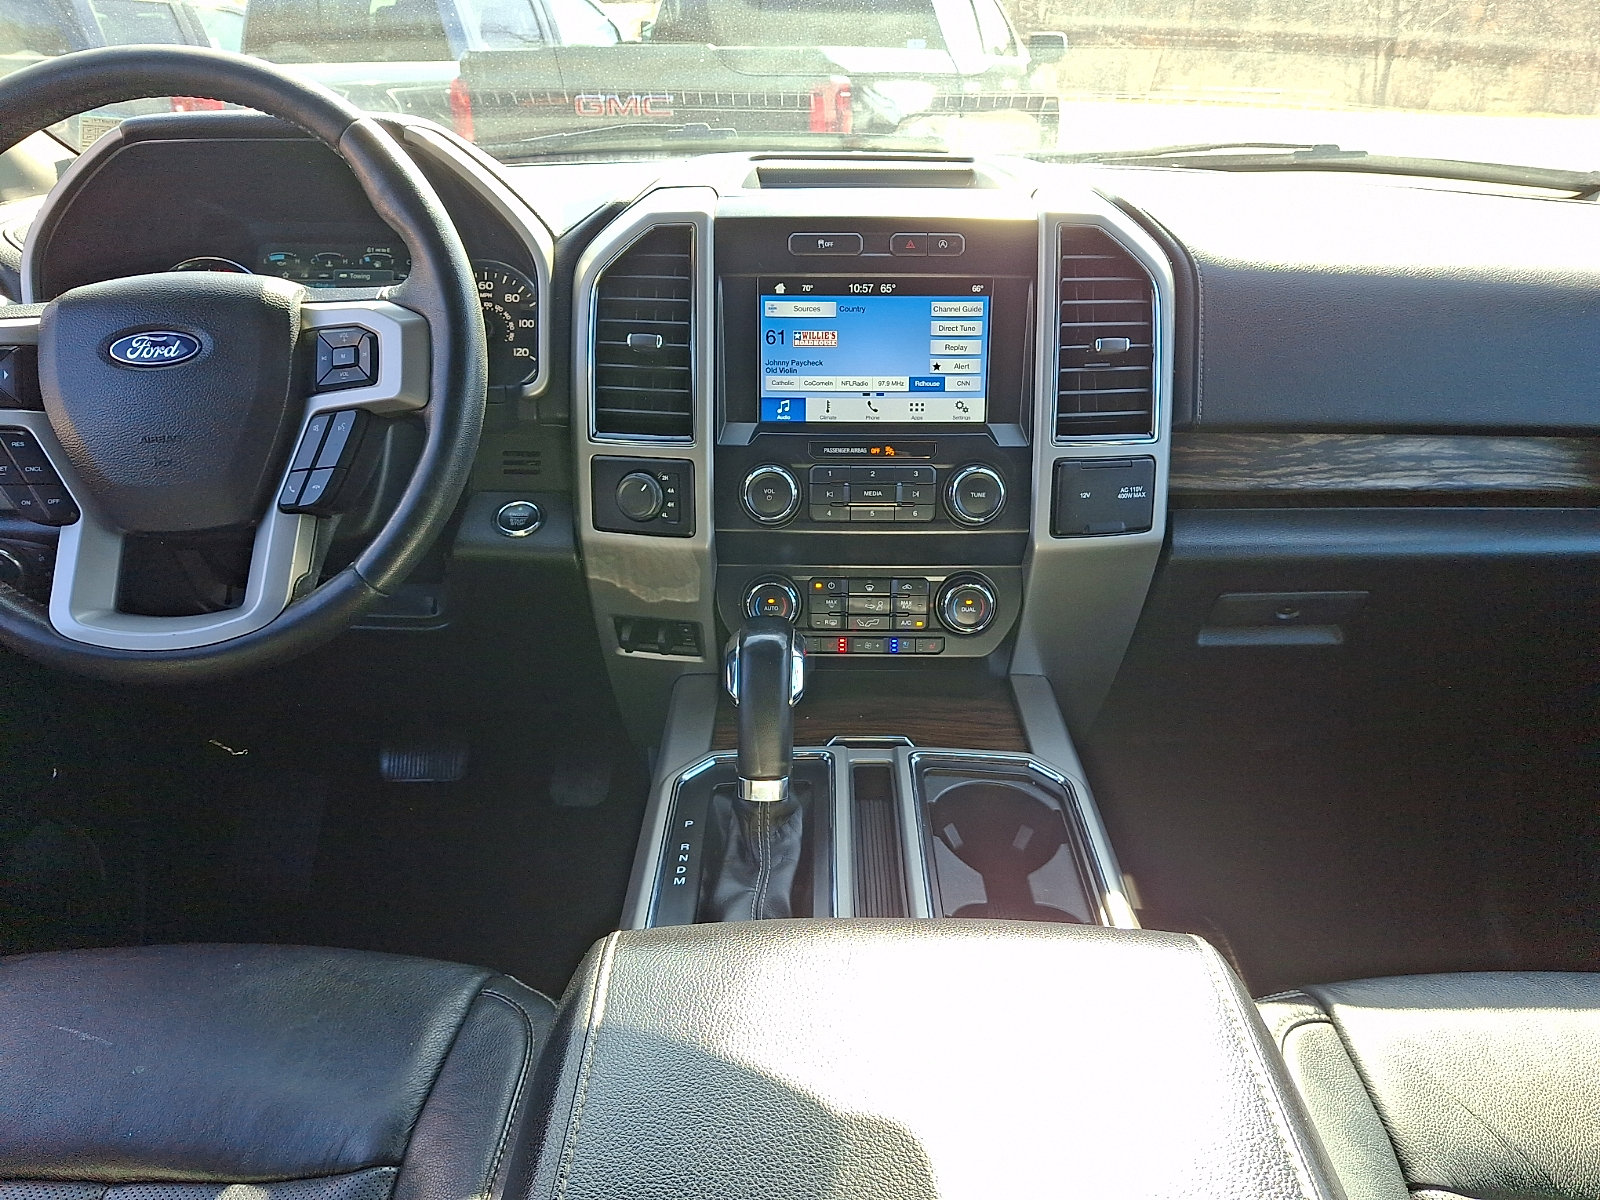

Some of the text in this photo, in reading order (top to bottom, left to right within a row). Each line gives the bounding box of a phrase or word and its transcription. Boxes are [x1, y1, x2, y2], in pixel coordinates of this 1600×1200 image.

[574, 94, 674, 117] GMC
[824, 240, 834, 248] OFF
[478, 281, 494, 290] 60
[848, 283, 874, 293] 10:57
[504, 293, 520, 303] 80
[839, 305, 866, 314] Country
[933, 305, 983, 313] Channel Guide
[518, 319, 535, 328] 100
[938, 324, 976, 332] Direct Tune
[765, 329, 785, 345] 61
[802, 331, 836, 340] WILLIE'S
[126, 335, 180, 359] Ford
[944, 344, 968, 352] Replay
[513, 347, 530, 357] 120
[765, 359, 824, 367] Johnny Paycheck
[953, 362, 970, 370] Alert
[684, 820, 694, 828] P
[680, 843, 690, 851] R
[678, 854, 689, 862] N
[676, 866, 687, 874] D
[673, 877, 686, 885] M
